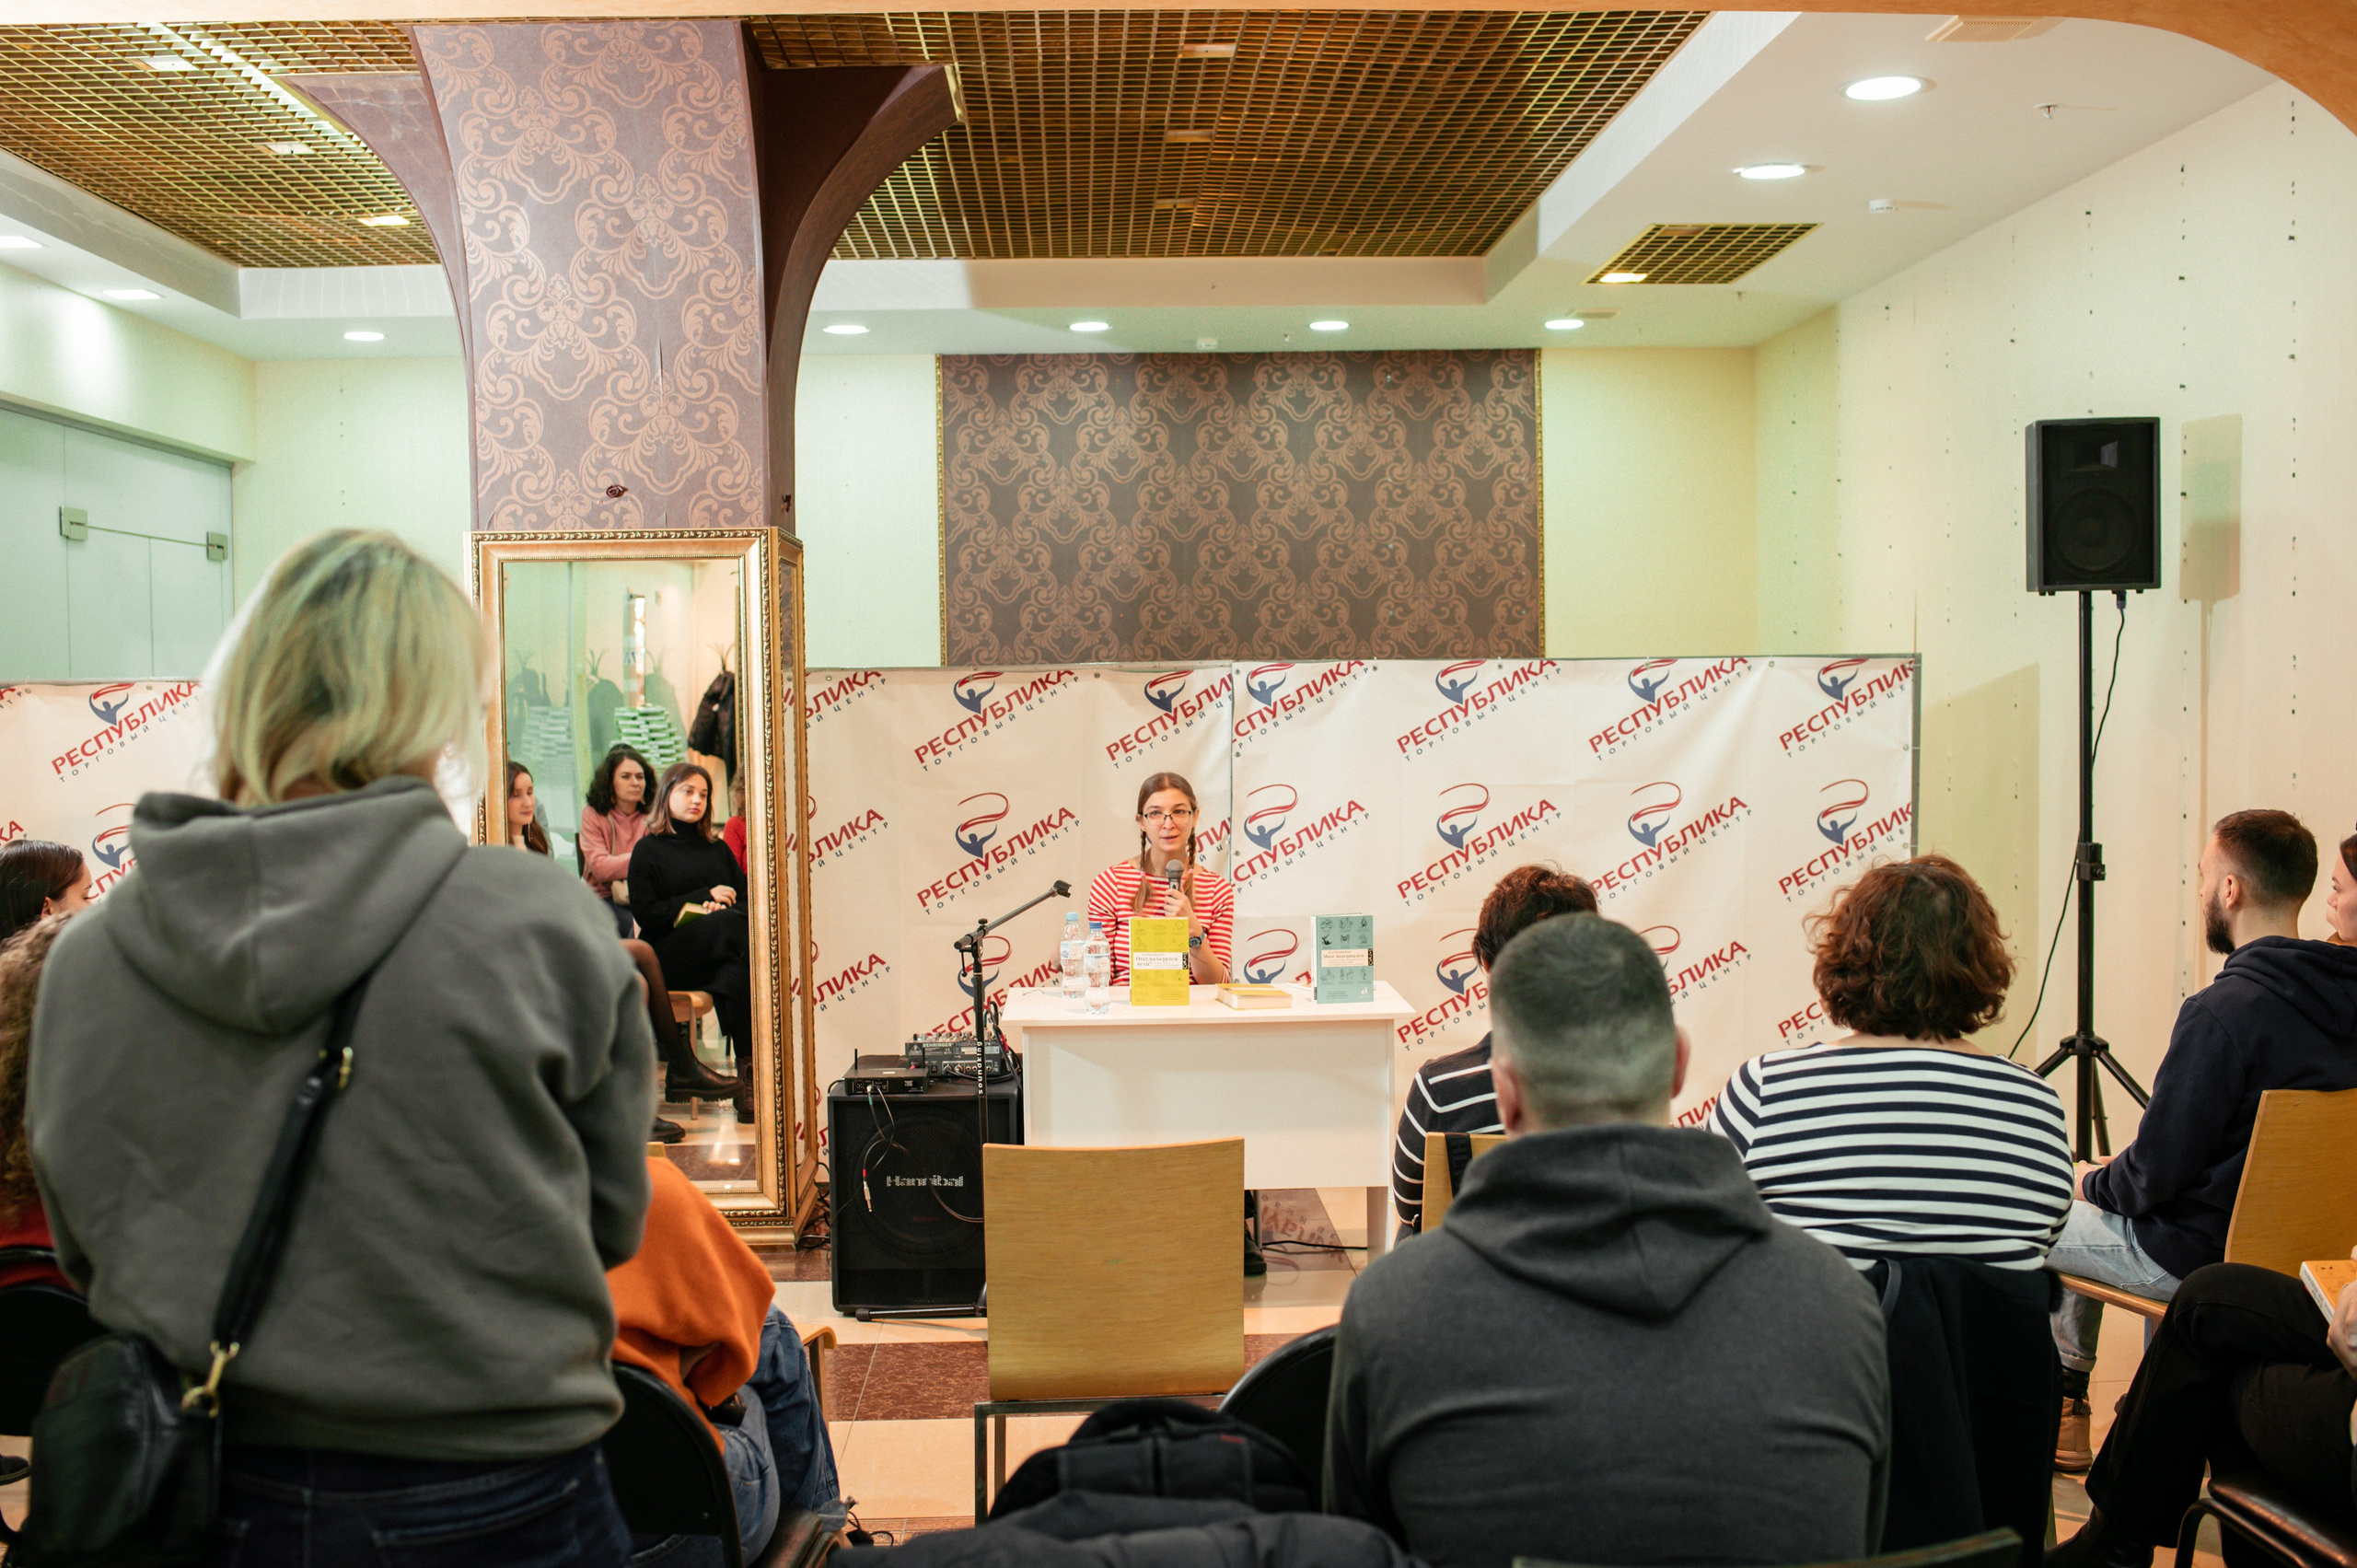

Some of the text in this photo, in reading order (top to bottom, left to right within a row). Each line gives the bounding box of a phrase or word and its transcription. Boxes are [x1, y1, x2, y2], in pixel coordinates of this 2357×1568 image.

[833, 678, 887, 713] ЦЕНТР
[914, 669, 1075, 764] РЕСПУБЛИКА
[923, 676, 1079, 772] ТОРГОВЫЙ ЦЕНТР
[1106, 673, 1232, 761] РЕСПУБЛИ
[1232, 660, 1365, 743] СПУБЛИКА
[1316, 667, 1369, 703] ЦЕНТР
[1397, 660, 1558, 754] РЕСПУБЛИКА
[1405, 668, 1562, 762] ТОРГОВЫЙ ЦЕНТР
[1588, 657, 1748, 754] РЕСПУБЛИКА
[1596, 665, 1753, 761] ТОРГОВЫЙ ЦЕНТР
[59, 693, 204, 783] ТОРГОВЫЙ ЦЕНТ
[1113, 711, 1206, 770] ТОРГОВЫЙ
[1787, 701, 1877, 758] ТОРГОВЫЙ
[835, 821, 888, 858] ЦЕНТР
[916, 807, 1076, 908] РЕСПУБЛИКА
[925, 819, 1080, 915] ТОРГОВЫЙ ЦЕНТР
[1231, 799, 1365, 888] СПУБЛИКА
[1316, 812, 1370, 848] ЦЕНТР
[1397, 799, 1558, 899] РЕСПУБЛИКА
[1405, 812, 1562, 907] ТОРГОВЫЙ ЦЕНТР
[1589, 796, 1747, 898] РЕСПУБЛИКА
[1597, 809, 1752, 906] ТОРГОВЫЙ ЦЕНТР
[1786, 844, 1877, 902] ТОРГОВЫЙ
[837, 966, 890, 1003] ЦЕНТР
[1397, 981, 1489, 1043] РЕСПУБ
[1699, 954, 1752, 989] ЦЕНТР
[1404, 1002, 1486, 1051] ТОРГОВЫ
[886, 1175, 964, 1188] Hannibal
